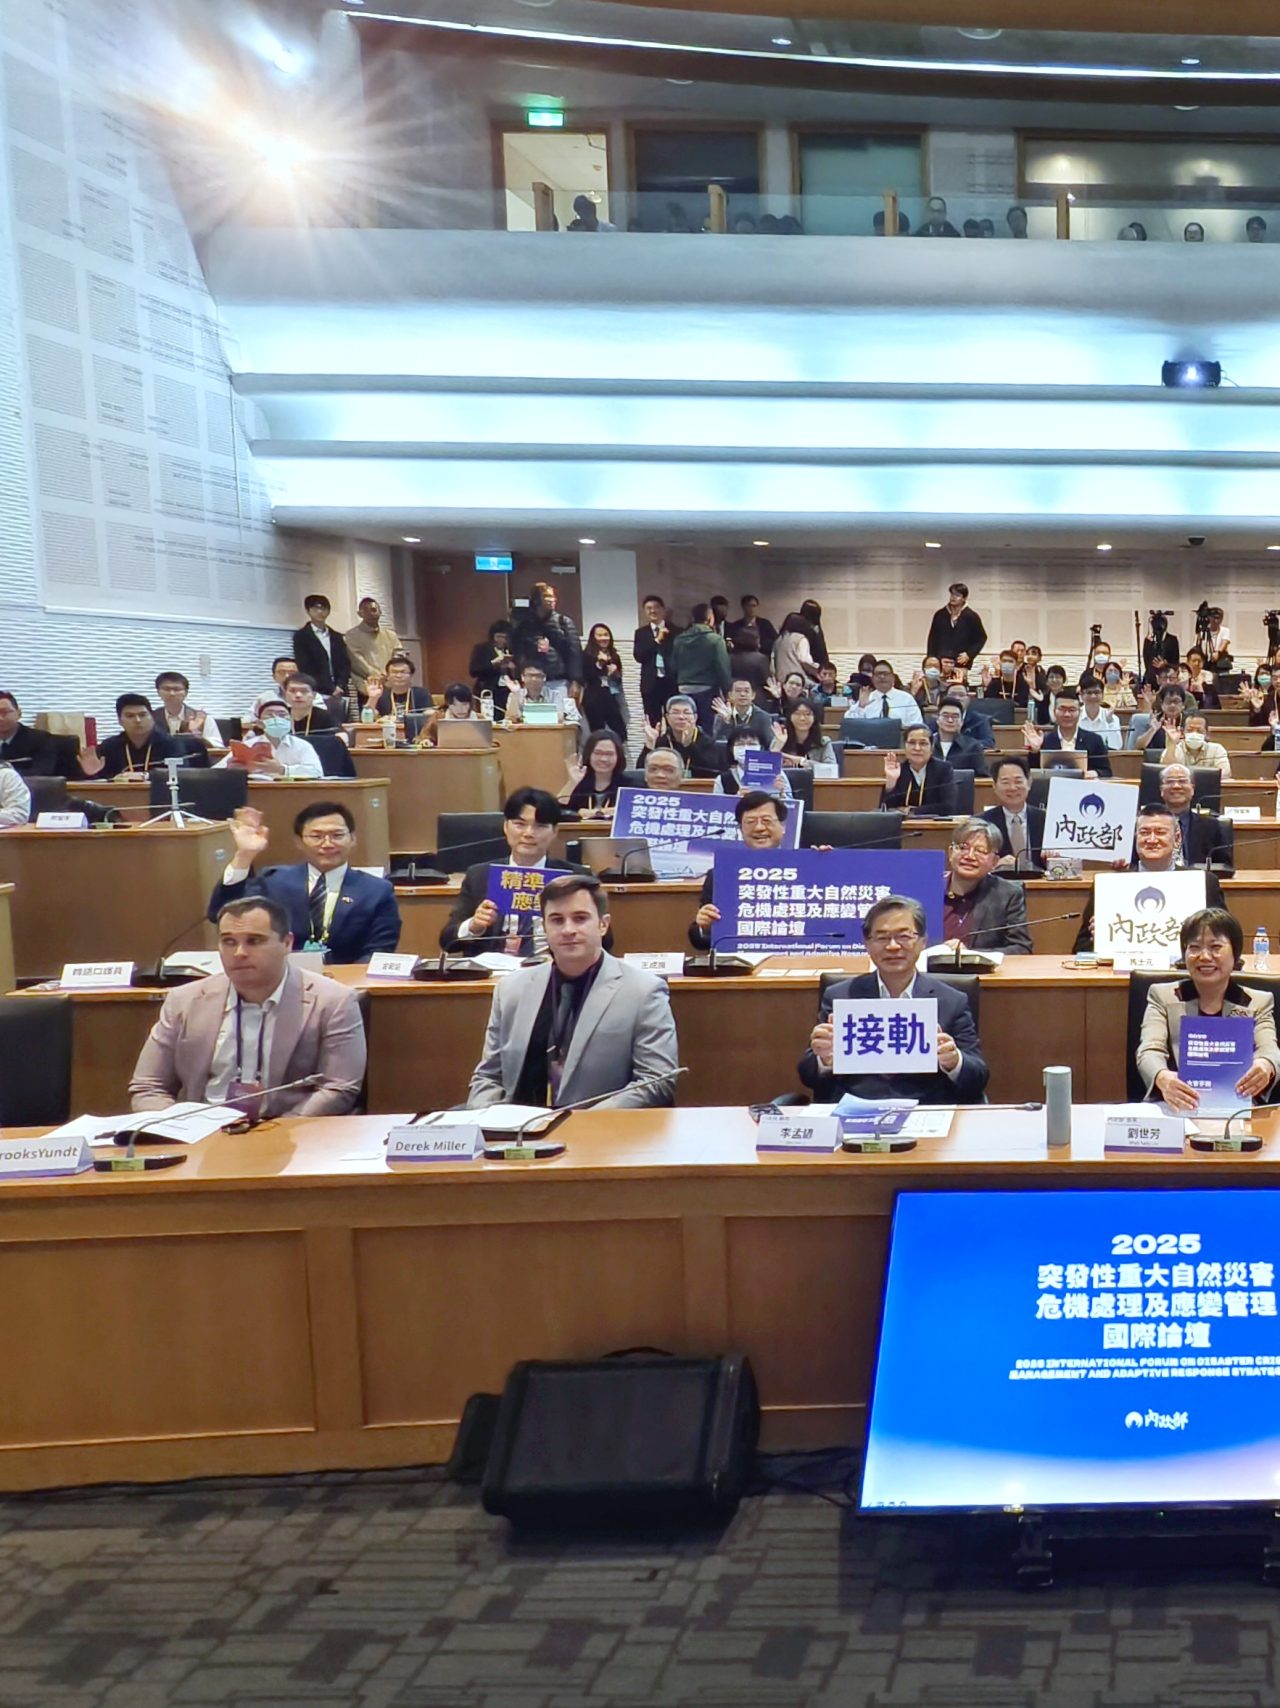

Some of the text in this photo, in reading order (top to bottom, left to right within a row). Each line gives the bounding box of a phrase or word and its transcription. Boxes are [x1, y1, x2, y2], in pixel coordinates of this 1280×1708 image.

[632, 794, 681, 805] 2025
[631, 805, 740, 826] 突發性重大自然
[629, 821, 745, 841] 危機處理及應變
[1055, 814, 1123, 850] 內政部
[501, 870, 544, 890] 精準
[738, 867, 798, 880] 2025
[737, 903, 870, 919] 危機處理及應變管
[737, 921, 805, 936] 國際論壇
[843, 1013, 930, 1056] 接軌
[1128, 1128, 1160, 1139] 劉世芳
[0, 1147, 79, 1160] rooksYundt
[395, 1141, 467, 1151] Derek Miller
[1111, 1234, 1201, 1255] 2025
[1037, 1262, 1275, 1289] 突發性重大自然災害
[1035, 1291, 1278, 1319] 危機處理及應變管理
[1103, 1322, 1211, 1349] 國際論壇
[1046, 1357, 1138, 1369] INTERNATIONAL
[1139, 1357, 1178, 1368] FORUM
[1180, 1357, 1196, 1367] ON
[1197, 1356, 1254, 1367] DISASTER
[1088, 1369, 1111, 1379] AND
[1112, 1368, 1169, 1378] ADAPTIVE
[1170, 1367, 1230, 1378] RESPONSE
